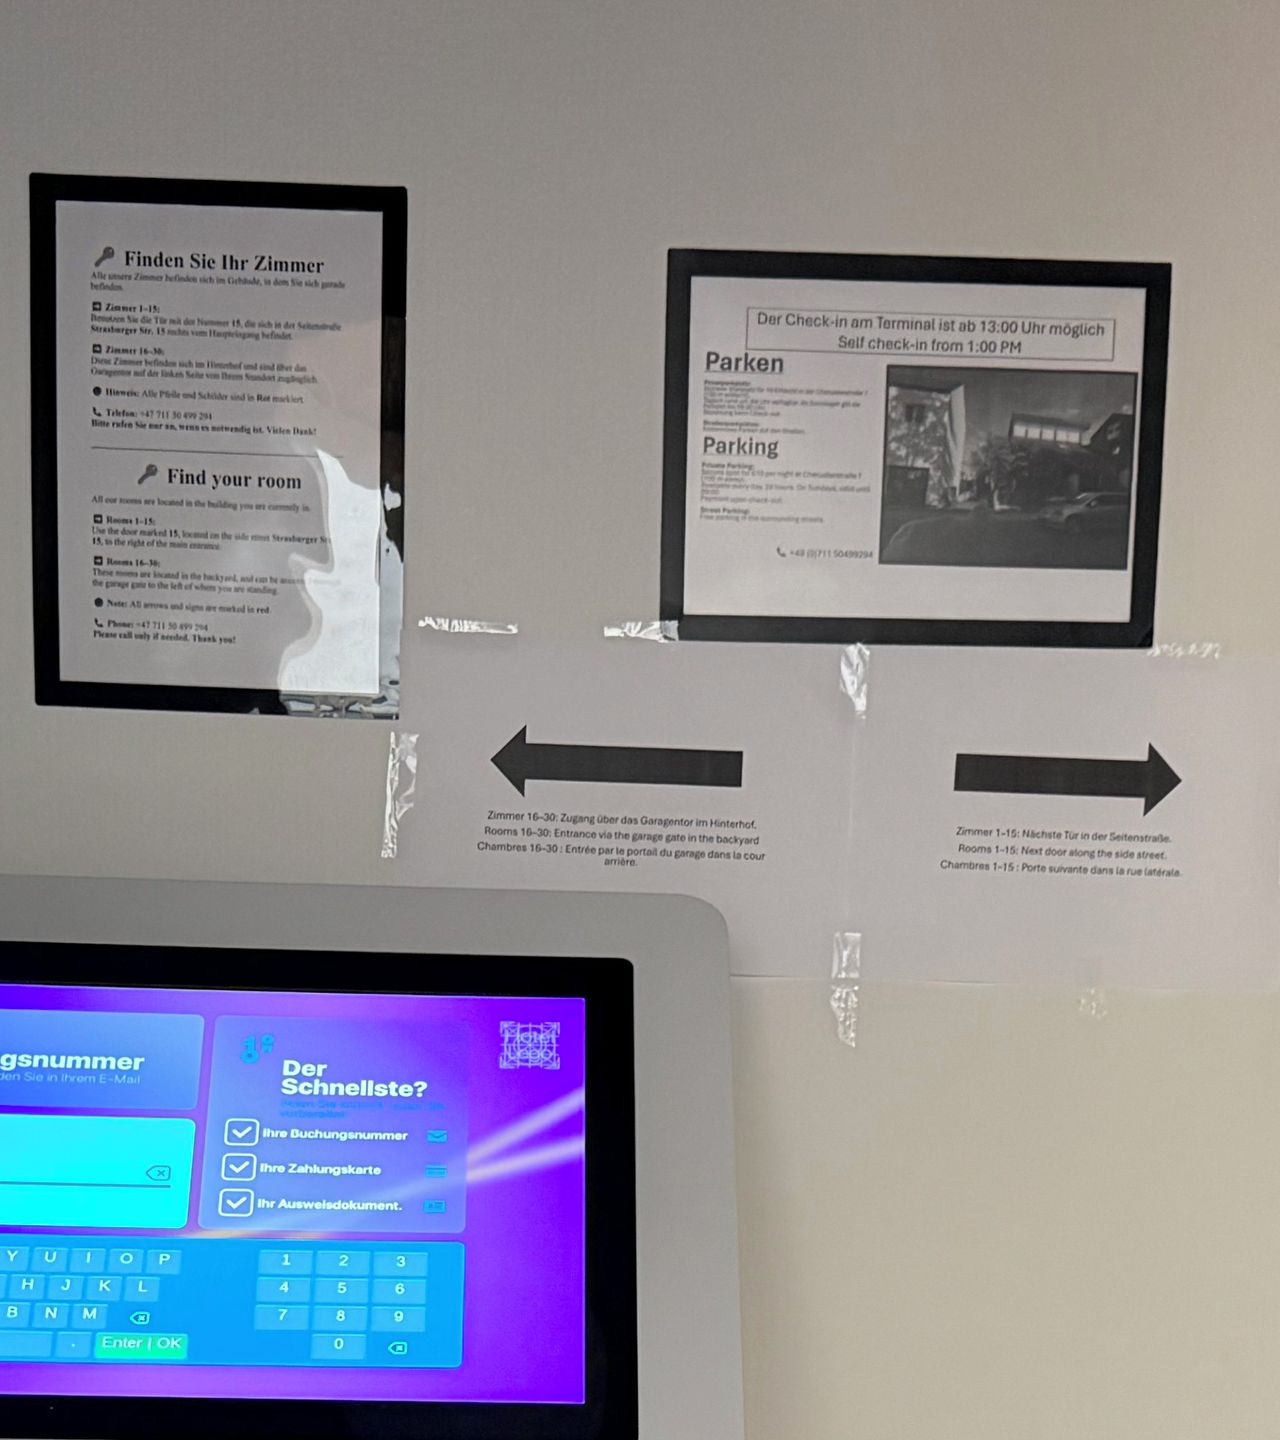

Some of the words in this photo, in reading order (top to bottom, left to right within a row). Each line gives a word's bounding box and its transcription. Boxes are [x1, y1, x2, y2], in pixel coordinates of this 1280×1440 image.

[125, 250, 184, 268] Finden
[190, 252, 216, 270] Sie
[221, 254, 249, 271] Ihr
[254, 255, 325, 273] Zimmer
[757, 312, 782, 326] Der
[785, 313, 847, 328] Check-in
[851, 318, 873, 329] am
[877, 316, 935, 331] Terminal
[938, 319, 955, 332] ist
[958, 320, 976, 332] ab
[980, 320, 1018, 334] 13:00
[1021, 321, 1046, 334] Uhr
[1049, 322, 1105, 339] möglich
[838, 335, 865, 349] Self
[869, 337, 928, 351] check-in
[931, 339, 963, 353] from
[967, 340, 997, 353] 1:00
[1000, 341, 1022, 354] PM
[705, 351, 784, 373] Parken
[703, 436, 779, 459] Parking
[167, 468, 206, 485] Find
[211, 474, 252, 490] your
[257, 475, 302, 489] room
[487, 810, 525, 821] Zimmer
[560, 813, 595, 825] Zugang
[597, 814, 619, 824] über
[621, 816, 638, 825] das
[640, 816, 694, 828] Garagentor
[695, 818, 708, 827] im
[710, 818, 757, 829] Hinterhof.
[484, 826, 518, 836] Rooms
[554, 828, 597, 839] Entrance
[598, 830, 613, 839] via
[614, 831, 630, 840] the
[631, 832, 663, 843] garage
[665, 833, 686, 843] gate
[687, 833, 697, 843] in
[699, 834, 715, 843] the
[716, 835, 760, 847] backyard
[956, 826, 993, 837] Zimmer
[1022, 829, 1062, 840] Nächste
[1064, 830, 1079, 840] Tür
[1080, 832, 1090, 840] in
[1091, 832, 1108, 841] der
[958, 843, 992, 854] Rooms
[1021, 846, 1043, 855] Next
[1044, 847, 1067, 857] door
[1069, 848, 1095, 860] along
[1097, 849, 1113, 858] the
[1114, 849, 1135, 859] side
[940, 859, 990, 871] Chambres
[1021, 862, 1047, 873] Porte
[1048, 865, 1089, 876] suivante
[1090, 865, 1114, 875] dans
[1115, 866, 1125, 875] la
[1126, 867, 1143, 877] rue
[282, 1059, 328, 1077] Der
[23, 1071, 44, 1082] Sie
[47, 1073, 58, 1082] in
[61, 1073, 96, 1083] Ihrem
[99, 1073, 141, 1085] E-Mail
[280, 1077, 428, 1098] Schnellste?
[262, 1128, 288, 1138] Ihre
[290, 1128, 409, 1142] Buchungsnummer
[259, 1162, 286, 1173] Ihre
[287, 1163, 382, 1176] Zahlungskarte
[257, 1198, 276, 1209] Ihr
[277, 1198, 403, 1212] Ausweisdokument.
[7, 1250, 18, 1262] Y
[44, 1251, 57, 1263] U
[120, 1252, 133, 1264] O
[159, 1253, 171, 1265] P
[281, 1253, 291, 1266] 1
[338, 1254, 349, 1267] 2
[395, 1255, 406, 1268] 3
[21, 1278, 34, 1290] H
[60, 1279, 71, 1291] J
[99, 1280, 111, 1292] K
[138, 1280, 148, 1293] L
[279, 1281, 289, 1293] 4
[337, 1281, 347, 1294] 5
[394, 1282, 405, 1295] 6
[6, 1306, 18, 1318] B
[45, 1306, 58, 1319] N
[82, 1307, 97, 1319] M
[278, 1308, 288, 1321] 7
[335, 1309, 346, 1322] 8
[393, 1310, 404, 1322] 9
[101, 1336, 143, 1349] Enter
[156, 1337, 182, 1349] OK
[333, 1337, 344, 1350] 0
